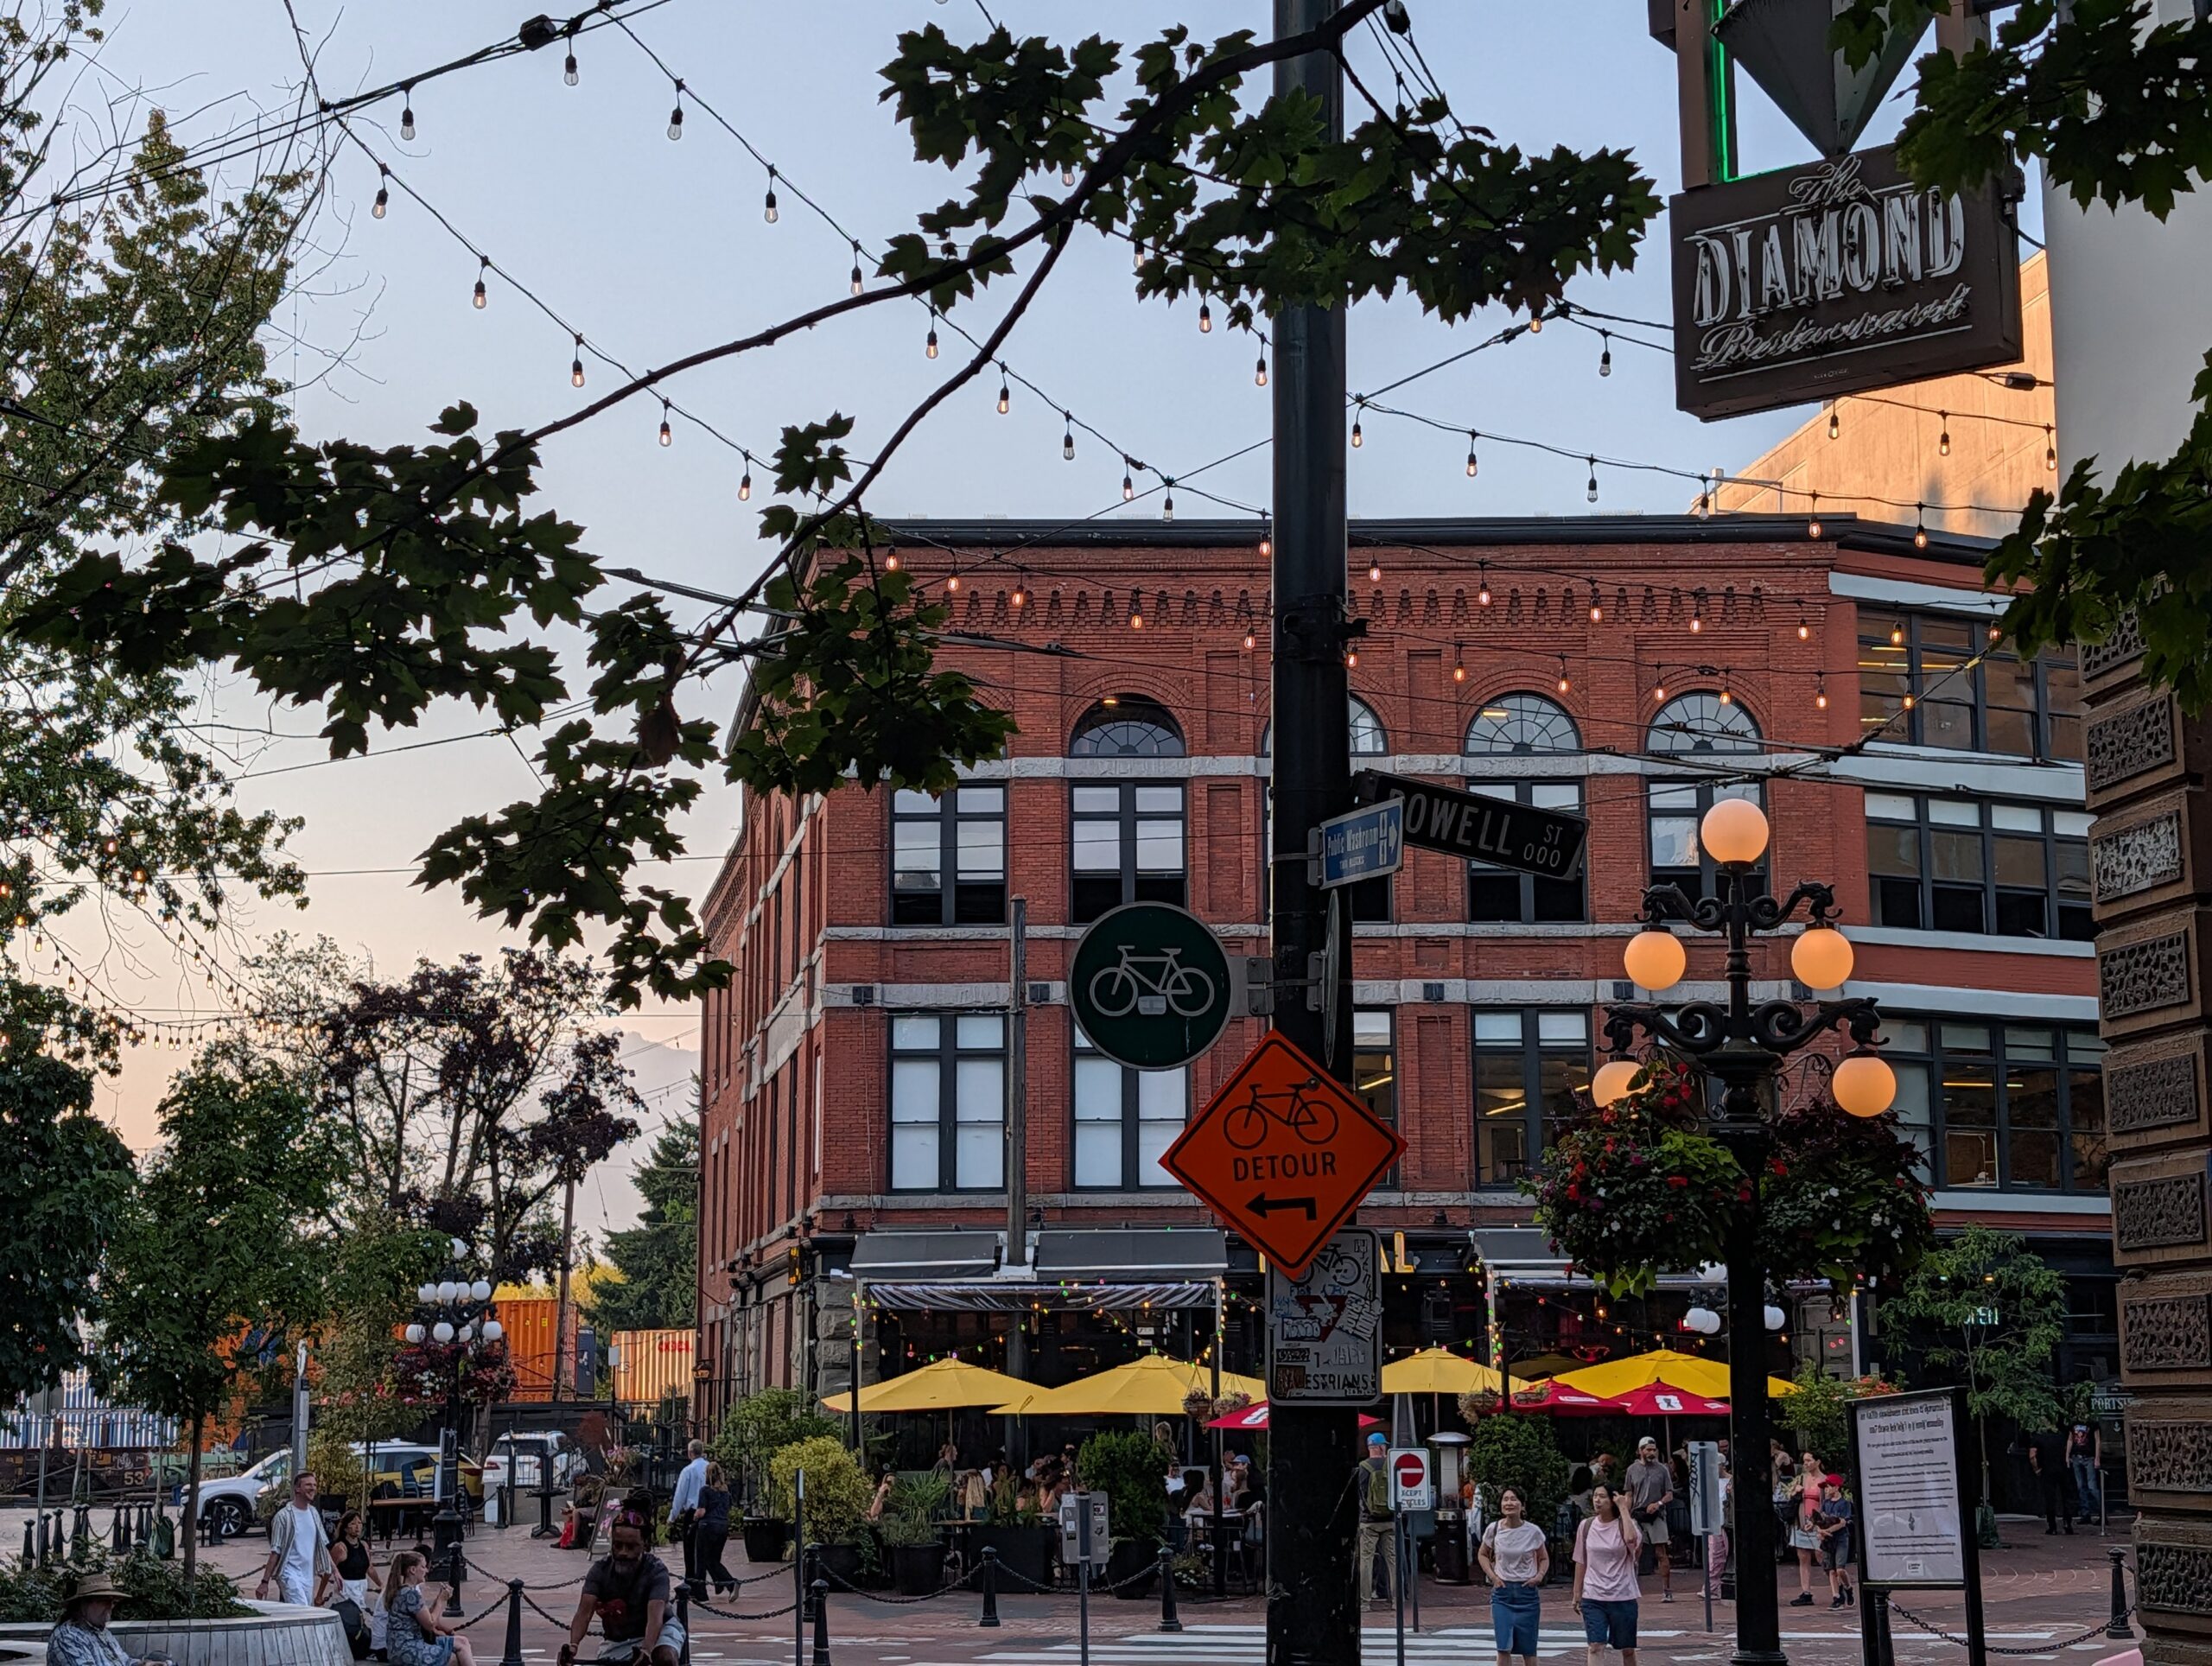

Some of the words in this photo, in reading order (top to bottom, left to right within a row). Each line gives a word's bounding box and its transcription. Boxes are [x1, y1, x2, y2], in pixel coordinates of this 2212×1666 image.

[1788, 154, 1868, 213] The
[1685, 186, 1965, 327] DIAMOND
[1327, 832, 1344, 857] Public
[1543, 823, 1564, 846] ST
[1522, 843, 1561, 868] 000
[1232, 1151, 1338, 1182] DETOUR
[124, 1472, 144, 1485] 53
